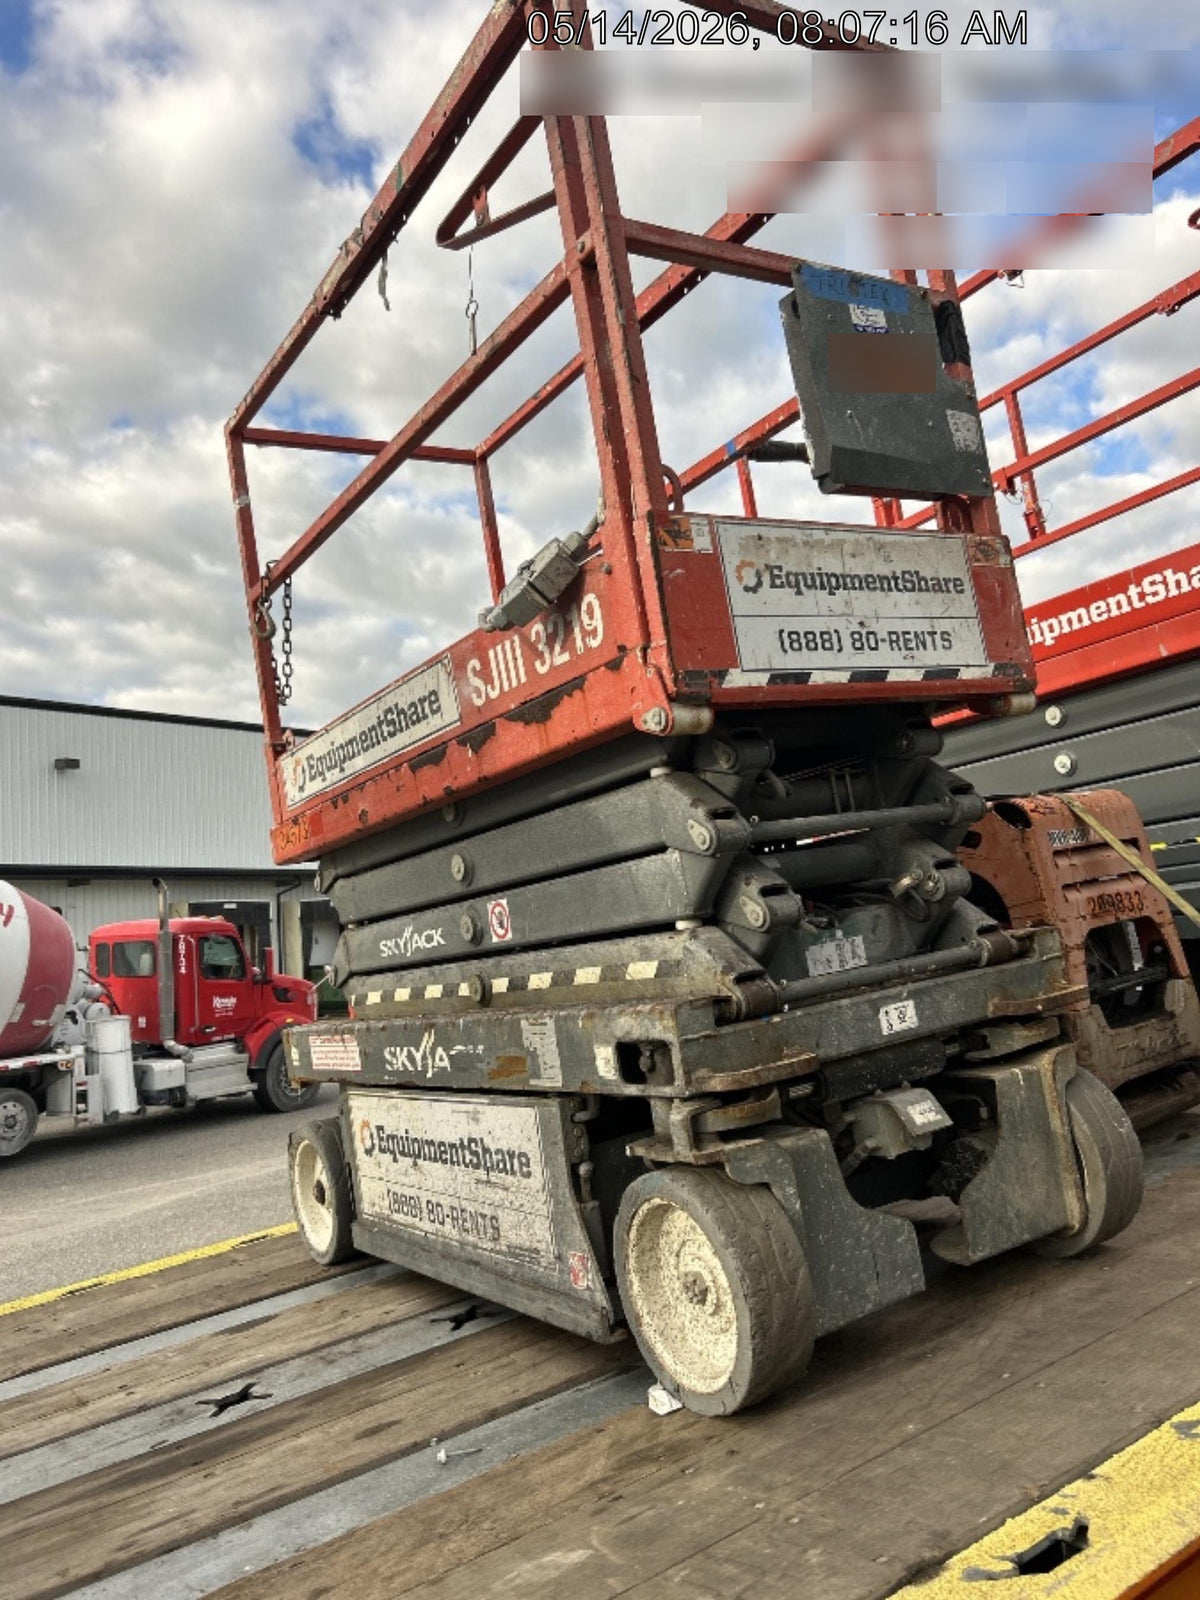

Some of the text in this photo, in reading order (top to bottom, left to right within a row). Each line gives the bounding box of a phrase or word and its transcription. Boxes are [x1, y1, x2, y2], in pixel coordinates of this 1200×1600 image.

[768, 564, 965, 596] EquipmentShare
[467, 593, 604, 706] SJIII 3219
[778, 629, 953, 653] (888) 80-RENTS
[305, 689, 443, 783] EquipmentShare
[380, 924, 446, 957] SKYJACK
[383, 1029, 484, 1078] SKYJA
[375, 1125, 532, 1179] EquipmentShare
[426, 1200, 500, 1242] 80-RENTS
